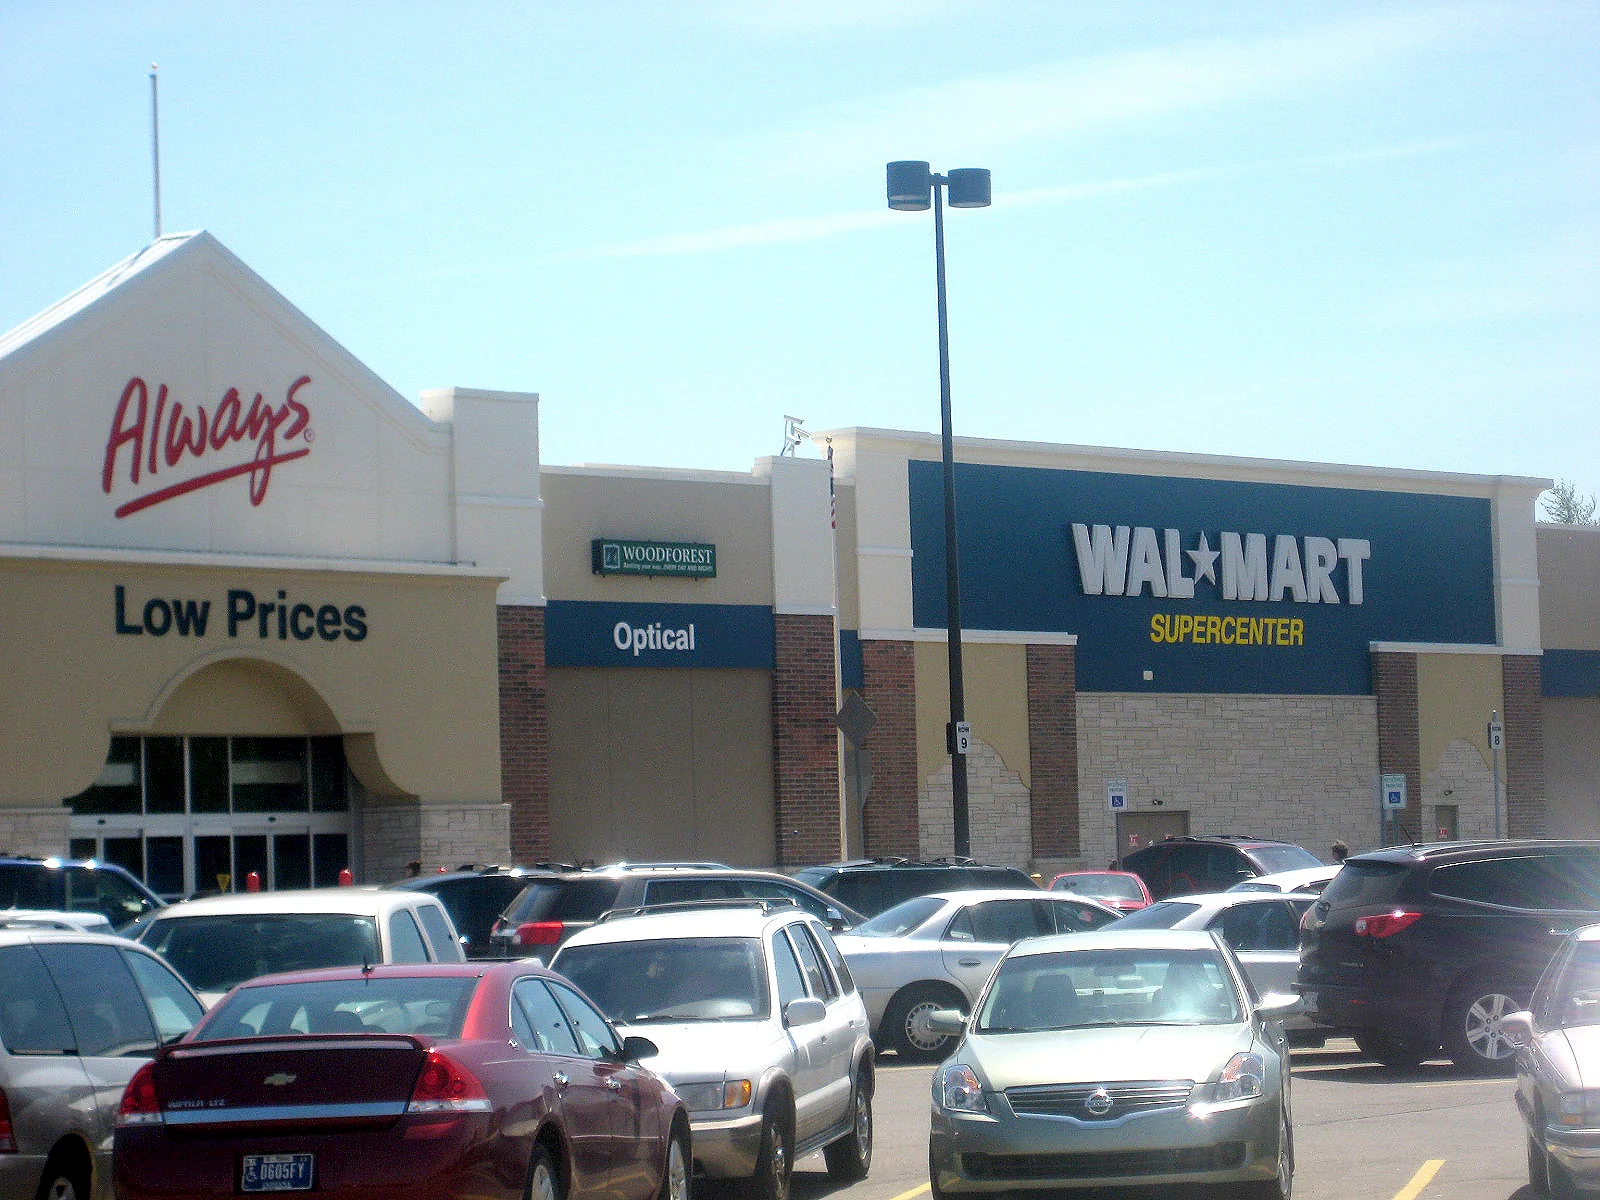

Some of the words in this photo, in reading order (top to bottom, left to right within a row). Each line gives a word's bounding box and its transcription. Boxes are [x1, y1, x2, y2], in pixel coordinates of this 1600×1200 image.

[102, 375, 312, 507] Always
[622, 545, 713, 564] WOODFOREST
[115, 585, 211, 637] Low
[228, 589, 368, 641] Prices
[1150, 613, 1304, 646] SUPERCENTER
[613, 621, 695, 657] Optical
[962, 738, 968, 749] 9
[1494, 735, 1500, 746] 8
